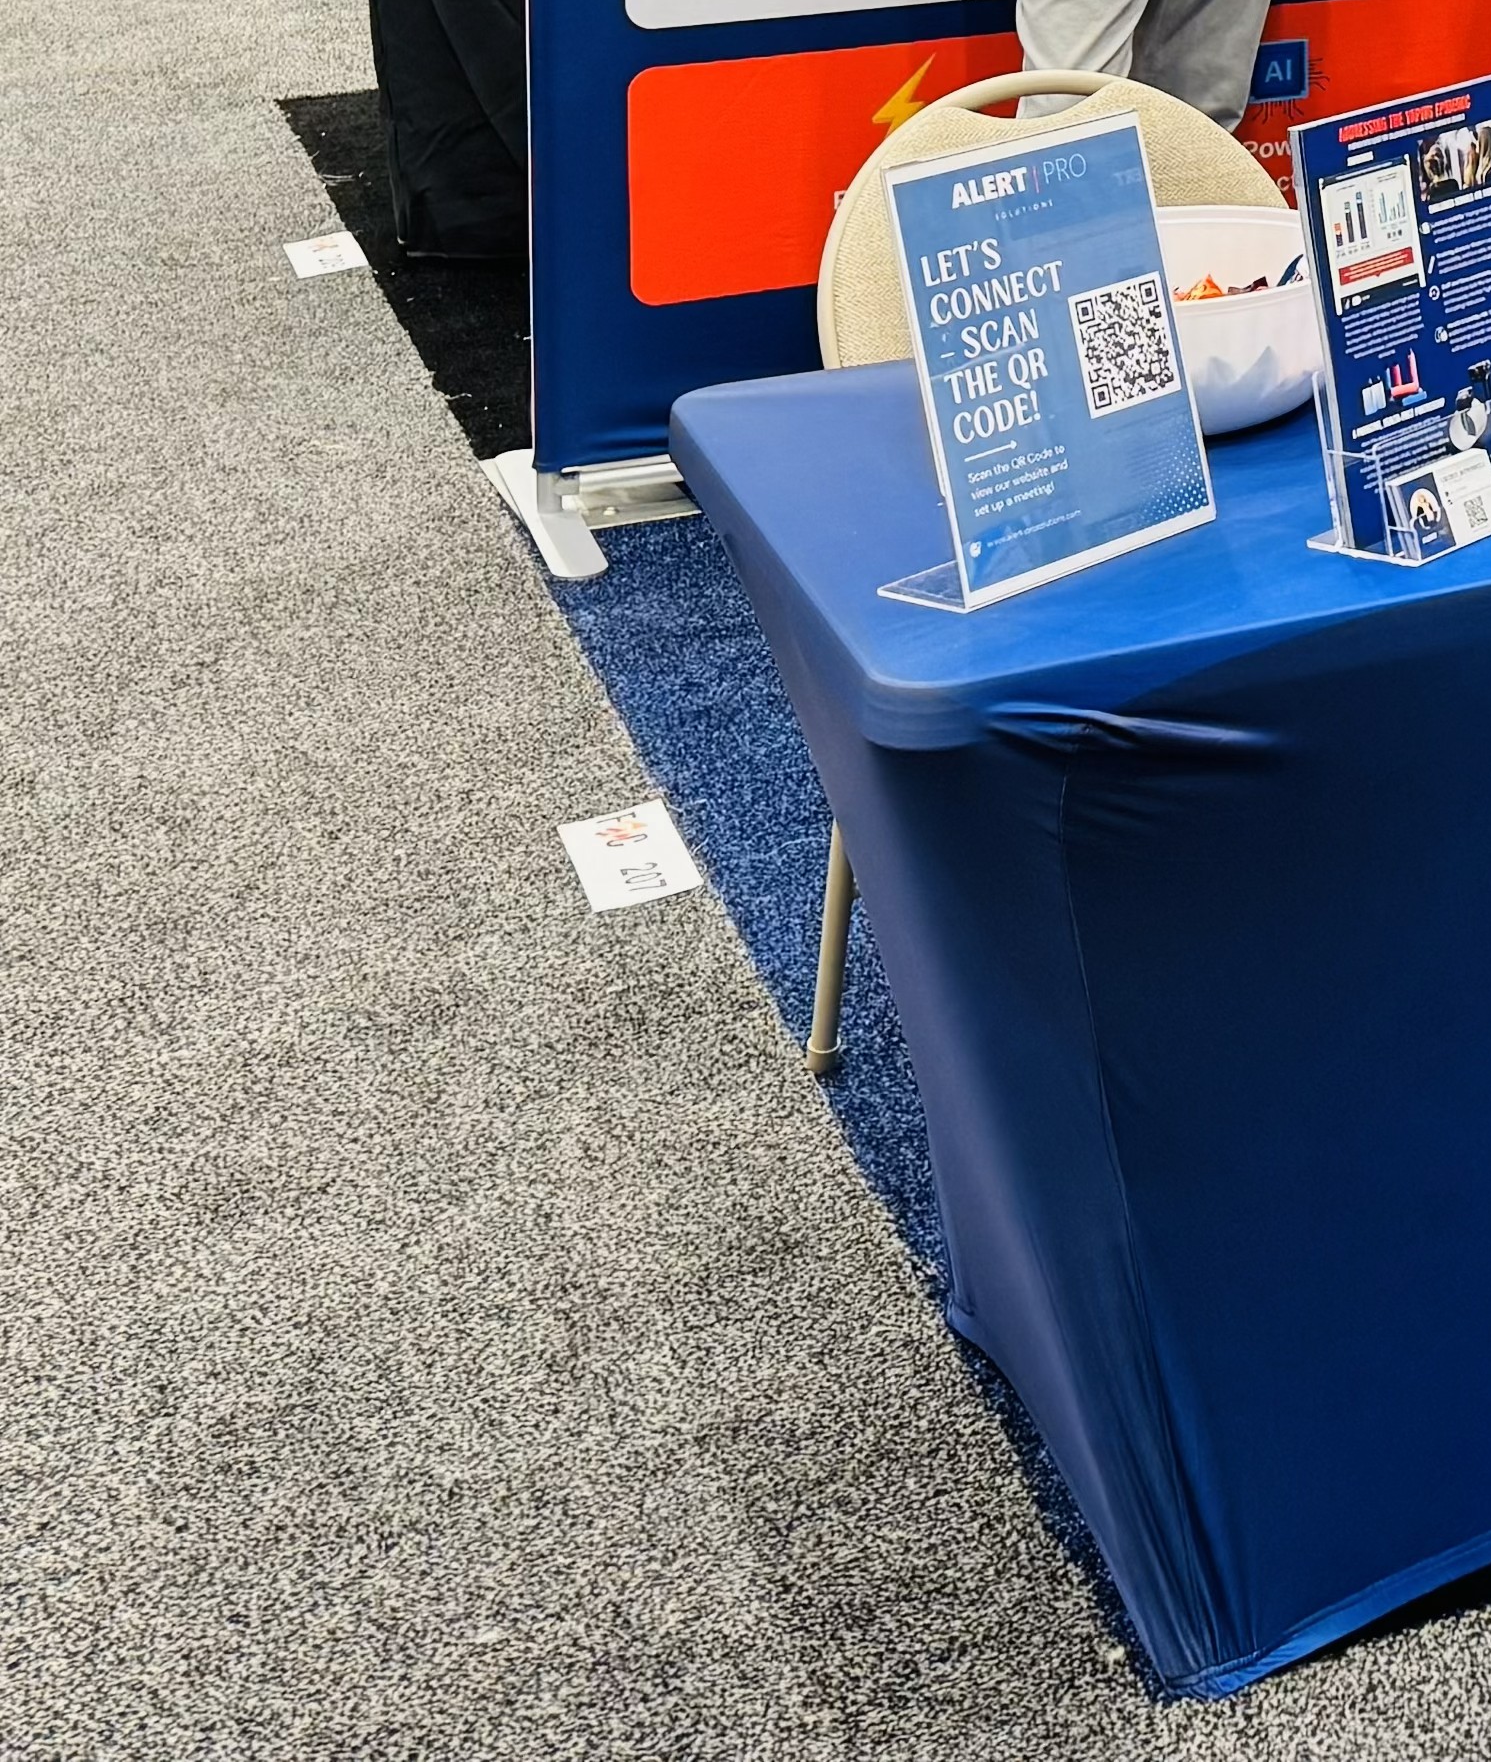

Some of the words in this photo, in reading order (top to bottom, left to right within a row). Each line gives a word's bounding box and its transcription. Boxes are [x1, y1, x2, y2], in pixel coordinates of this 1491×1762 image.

[1264, 60, 1293, 84] AI
[951, 166, 1028, 211] ALERT
[1042, 153, 1087, 185] PRO
[920, 238, 1002, 289] LET'S
[930, 259, 1064, 328] CONNECT
[962, 308, 1040, 360] SCAN
[943, 359, 1004, 406] THE
[1007, 347, 1049, 390] QR
[952, 390, 1042, 445] CODE!
[619, 862, 668, 892] 207
